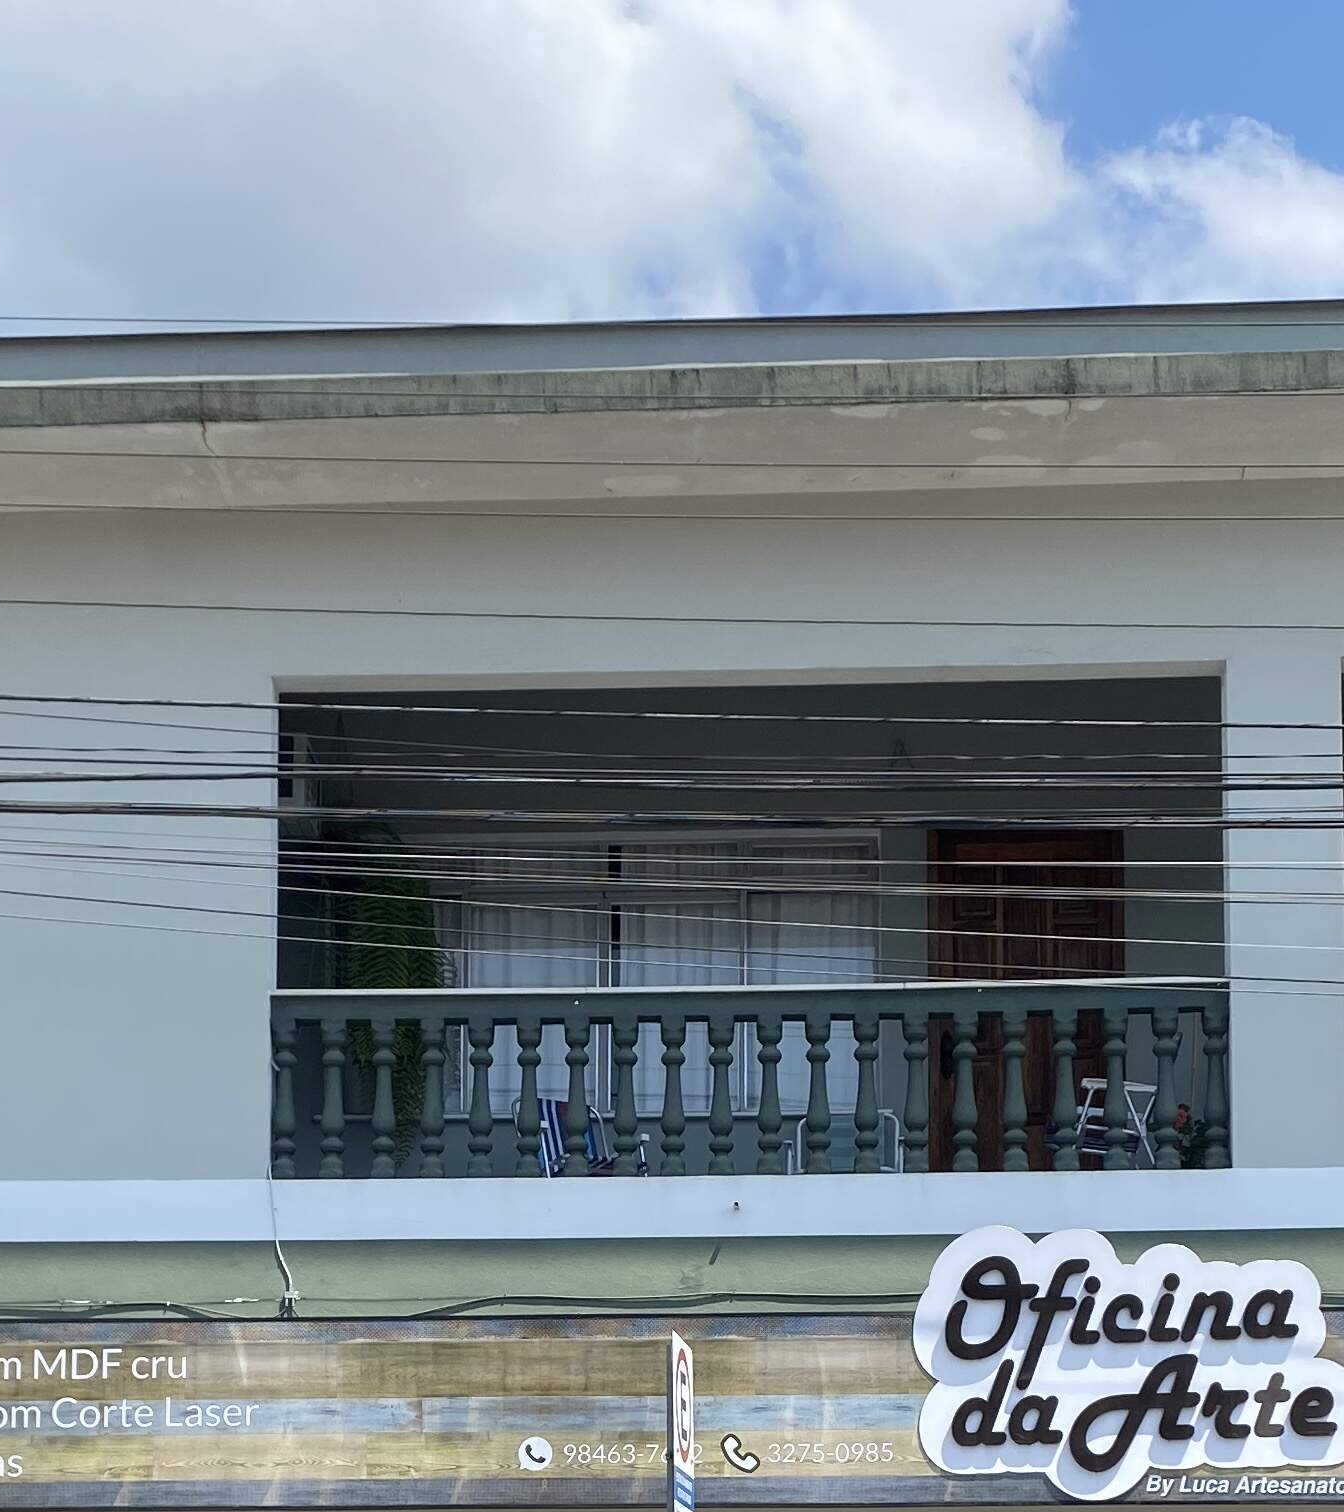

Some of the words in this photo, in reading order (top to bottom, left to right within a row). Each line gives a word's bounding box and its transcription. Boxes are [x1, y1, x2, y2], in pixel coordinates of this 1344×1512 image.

[944, 1254, 1299, 1390] Oficina
[33, 1348, 122, 1381] MDF
[130, 1352, 188, 1380] cru
[50, 1396, 156, 1429] Corte
[164, 1395, 259, 1429] Laser
[951, 1358, 1063, 1446] da
[1069, 1353, 1338, 1473] Arte
[767, 1442, 895, 1464] 3275-0985
[1146, 1475, 1175, 1498] By
[1179, 1474, 1230, 1495] Luca
